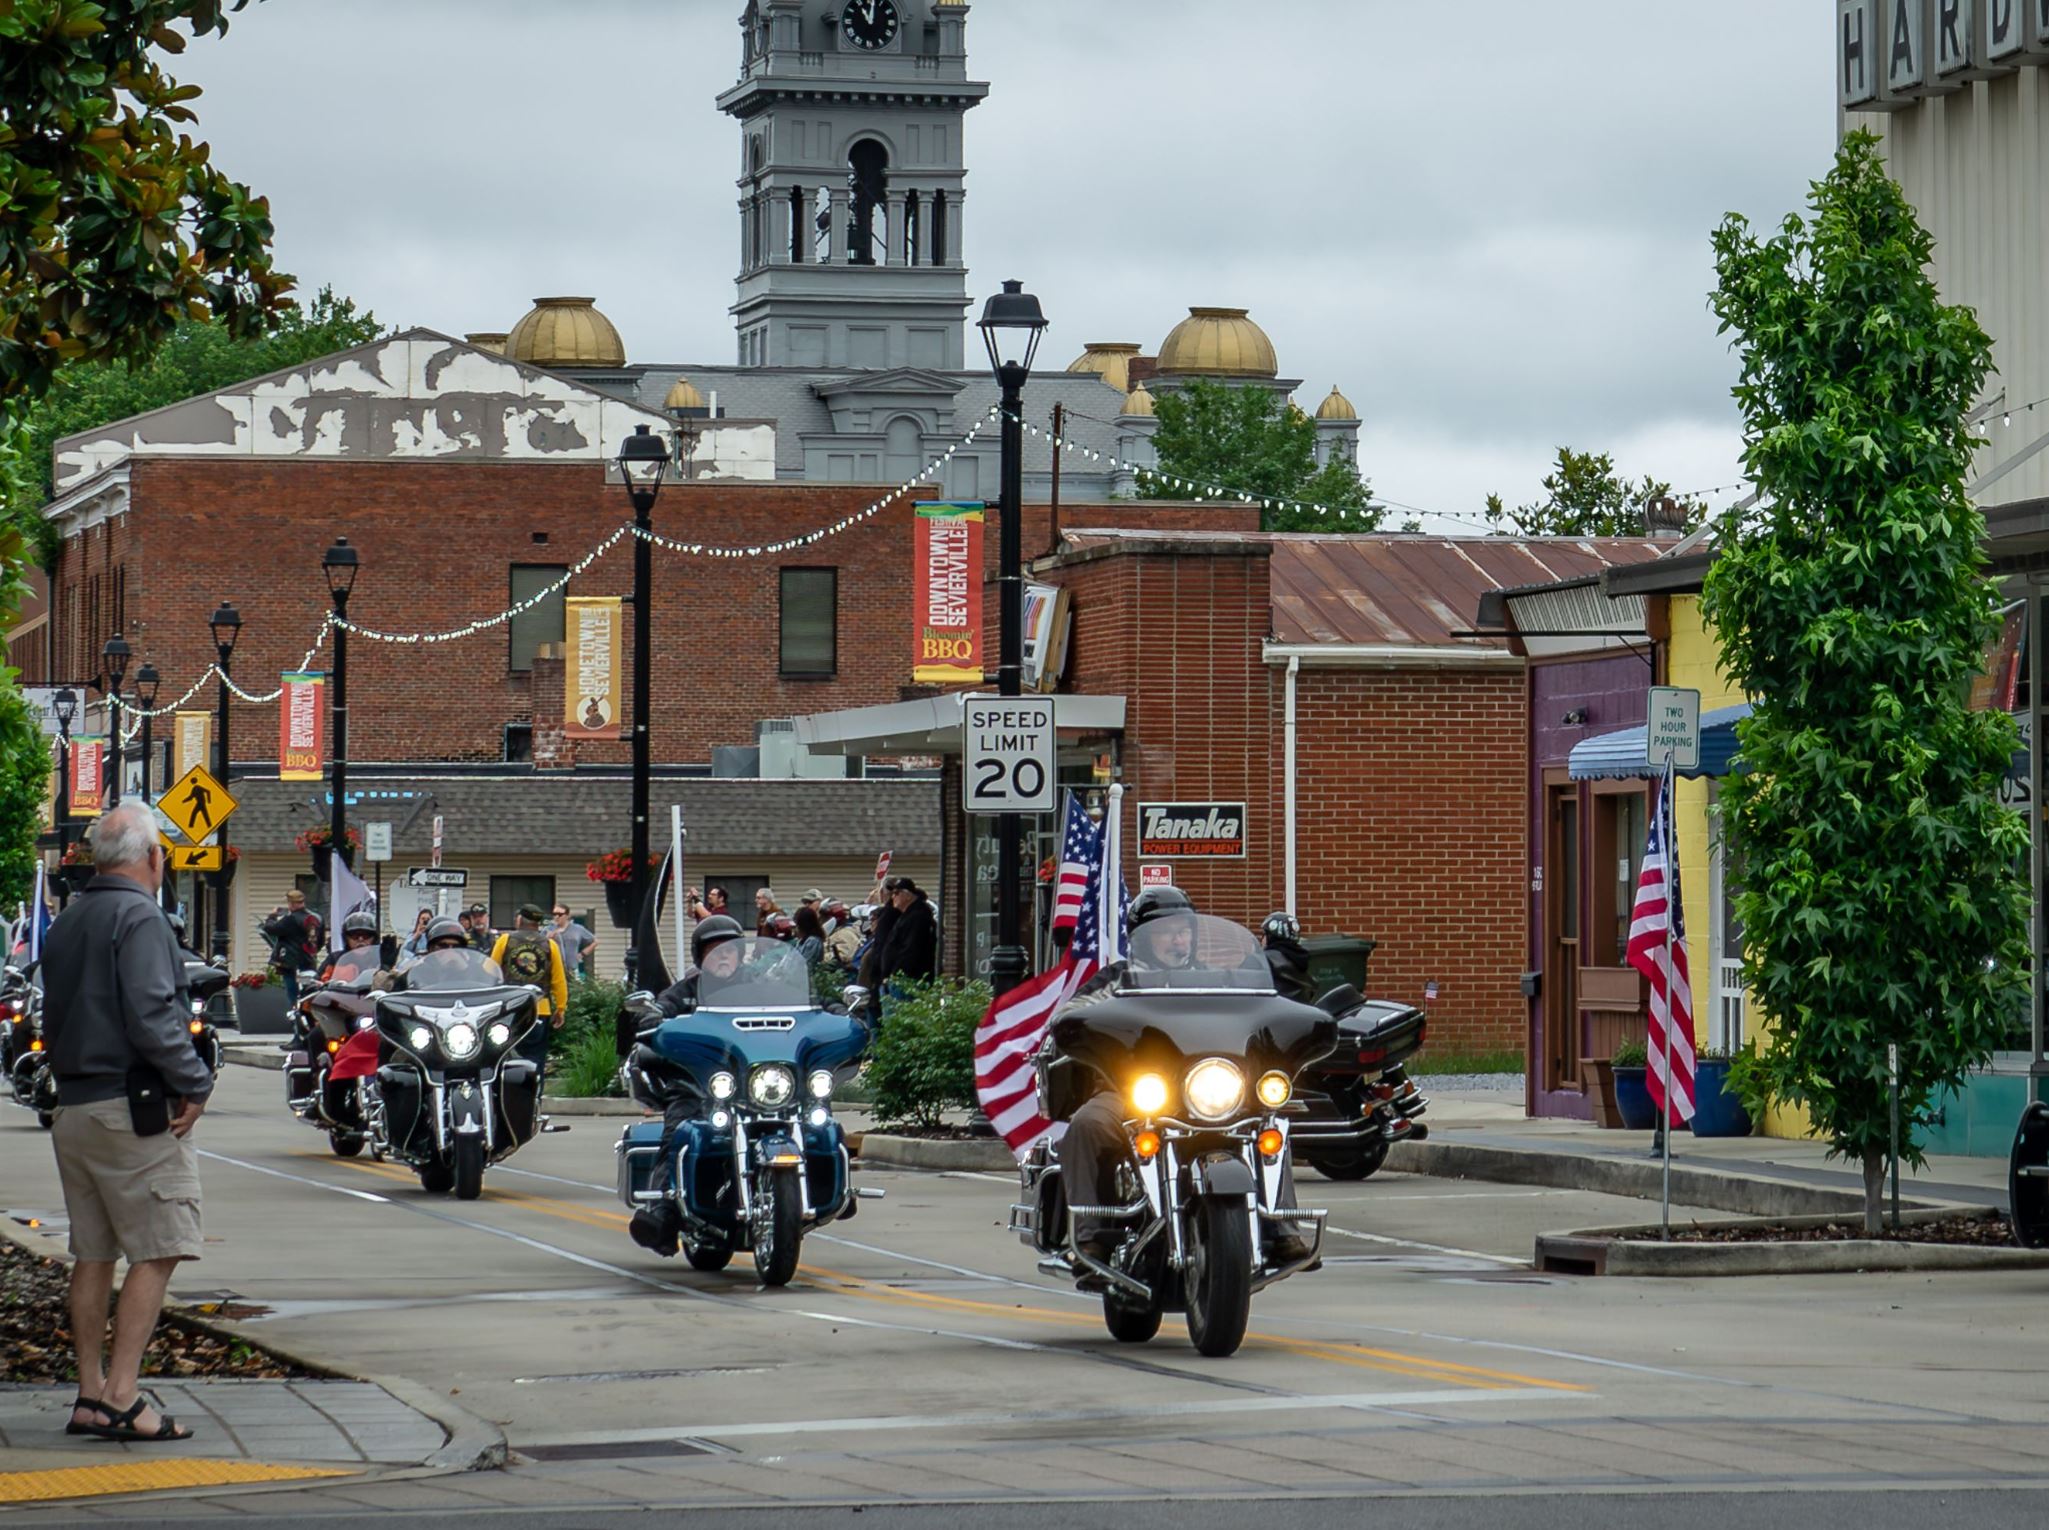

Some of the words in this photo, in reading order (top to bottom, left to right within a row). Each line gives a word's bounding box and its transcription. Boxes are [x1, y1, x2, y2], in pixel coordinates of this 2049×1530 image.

[929, 529, 949, 626] DOWNTOWN
[949, 528, 968, 626] SEVIERVILLE
[579, 619, 595, 695] HOMETOWN
[595, 619, 610, 695] SEVIERVILLE
[922, 639, 973, 659] BBQ
[972, 711, 1048, 728] SPEED
[1665, 707, 1684, 718] TWO
[1661, 722, 1687, 732] HOUR
[981, 734, 1039, 751] LIMIT
[1654, 736, 1692, 747] PARKING
[286, 754, 317, 768] BBQ
[974, 758, 1045, 798] 20
[74, 796, 98, 805] BBQ
[1144, 808, 1239, 839] Tanaka
[1143, 844, 1180, 854] POWER
[1183, 844, 1240, 854] EQUIPMENT
